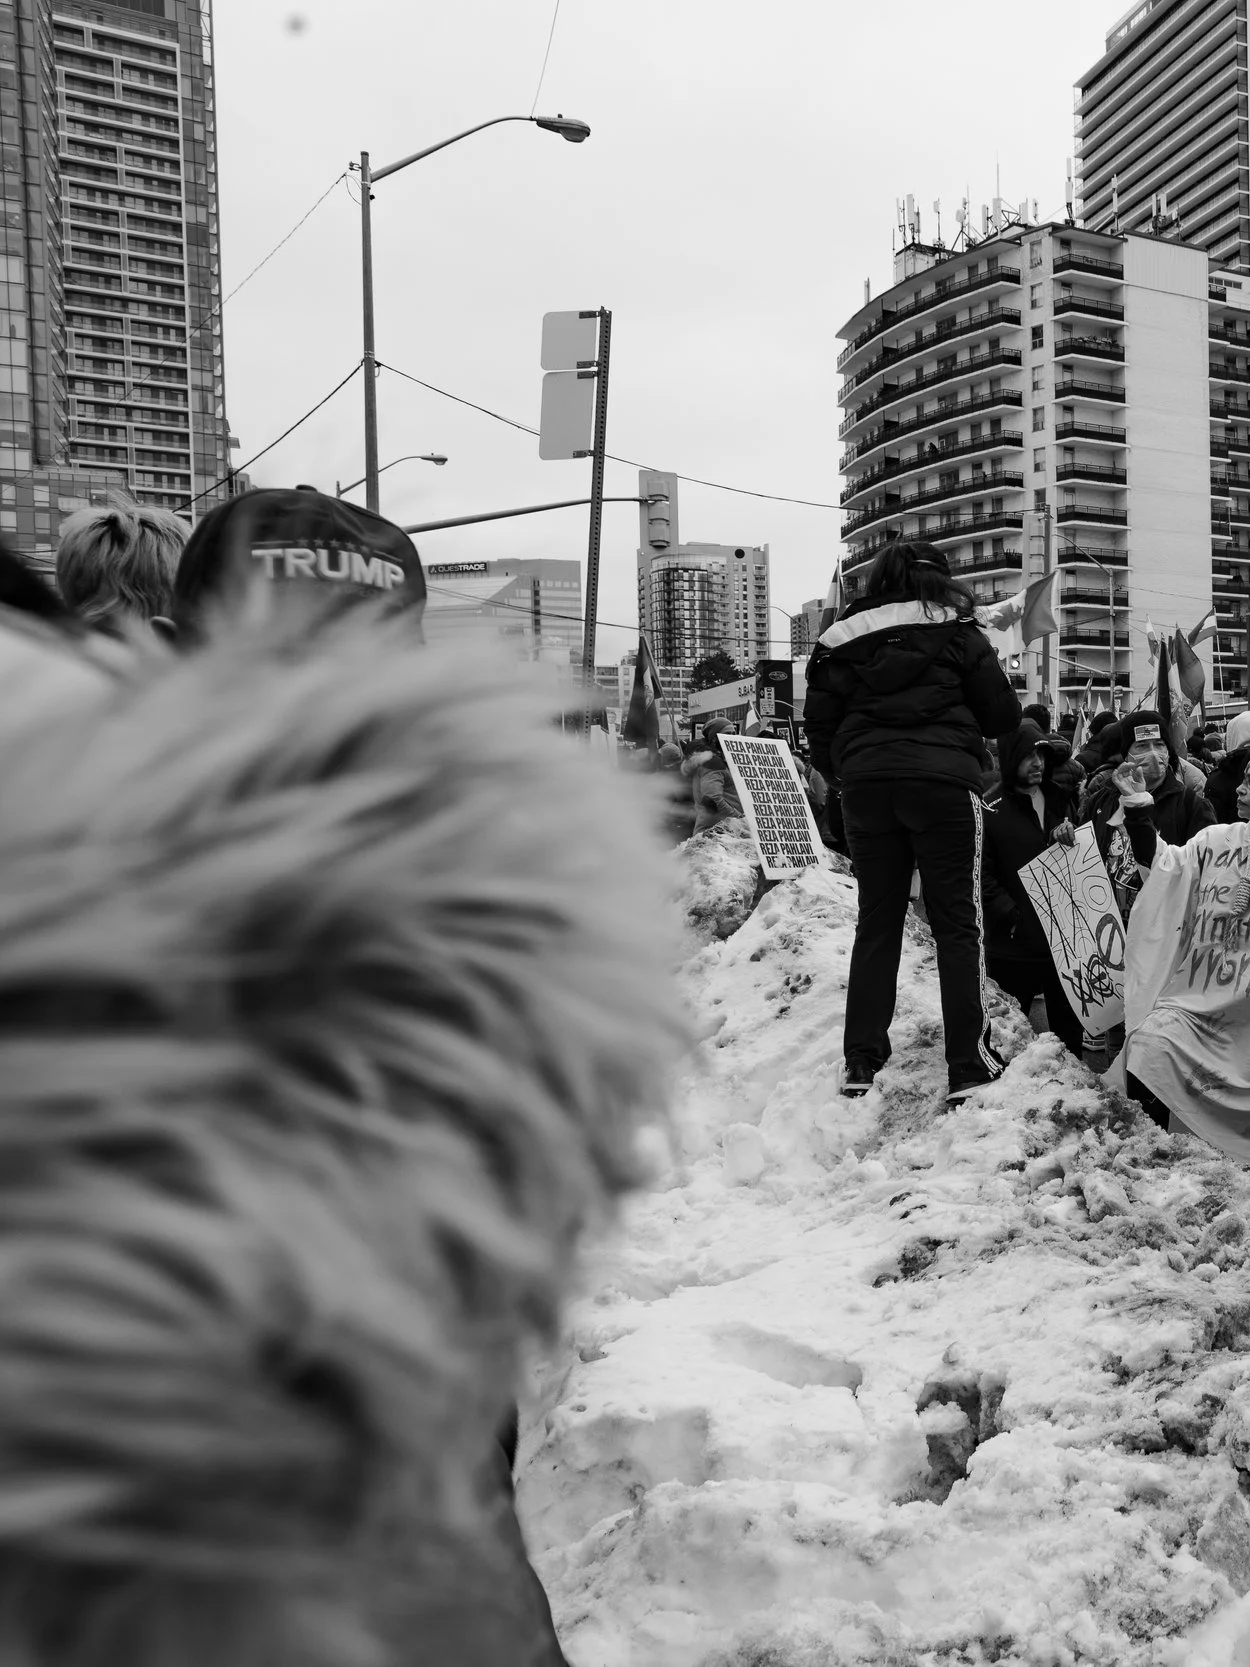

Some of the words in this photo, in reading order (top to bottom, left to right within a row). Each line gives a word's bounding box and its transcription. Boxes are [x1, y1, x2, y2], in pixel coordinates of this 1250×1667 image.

[251, 548, 405, 590] TRUMP
[437, 563, 486, 573] QUESTRADE
[724, 740, 746, 753] REZA
[745, 741, 779, 755] PAHLAVI
[731, 752, 753, 765] REZA
[751, 754, 786, 768] PAHLAVI
[738, 766, 759, 778] REZA
[758, 767, 792, 780] PAHLAVI
[744, 779, 766, 791] REZA
[765, 780, 799, 793] PAHLAVI
[751, 791, 772, 804] REZA
[771, 792, 805, 805] PAHLAVI
[753, 804, 775, 816] REZA
[773, 805, 807, 817] PAHLAVI
[755, 817, 777, 829] REZA
[775, 818, 809, 830] PAHLAVI
[757, 830, 779, 842] REZA
[777, 830, 812, 842] PAHLAVI
[759, 843, 780, 855] REZA
[779, 843, 814, 855] PAHLAVI
